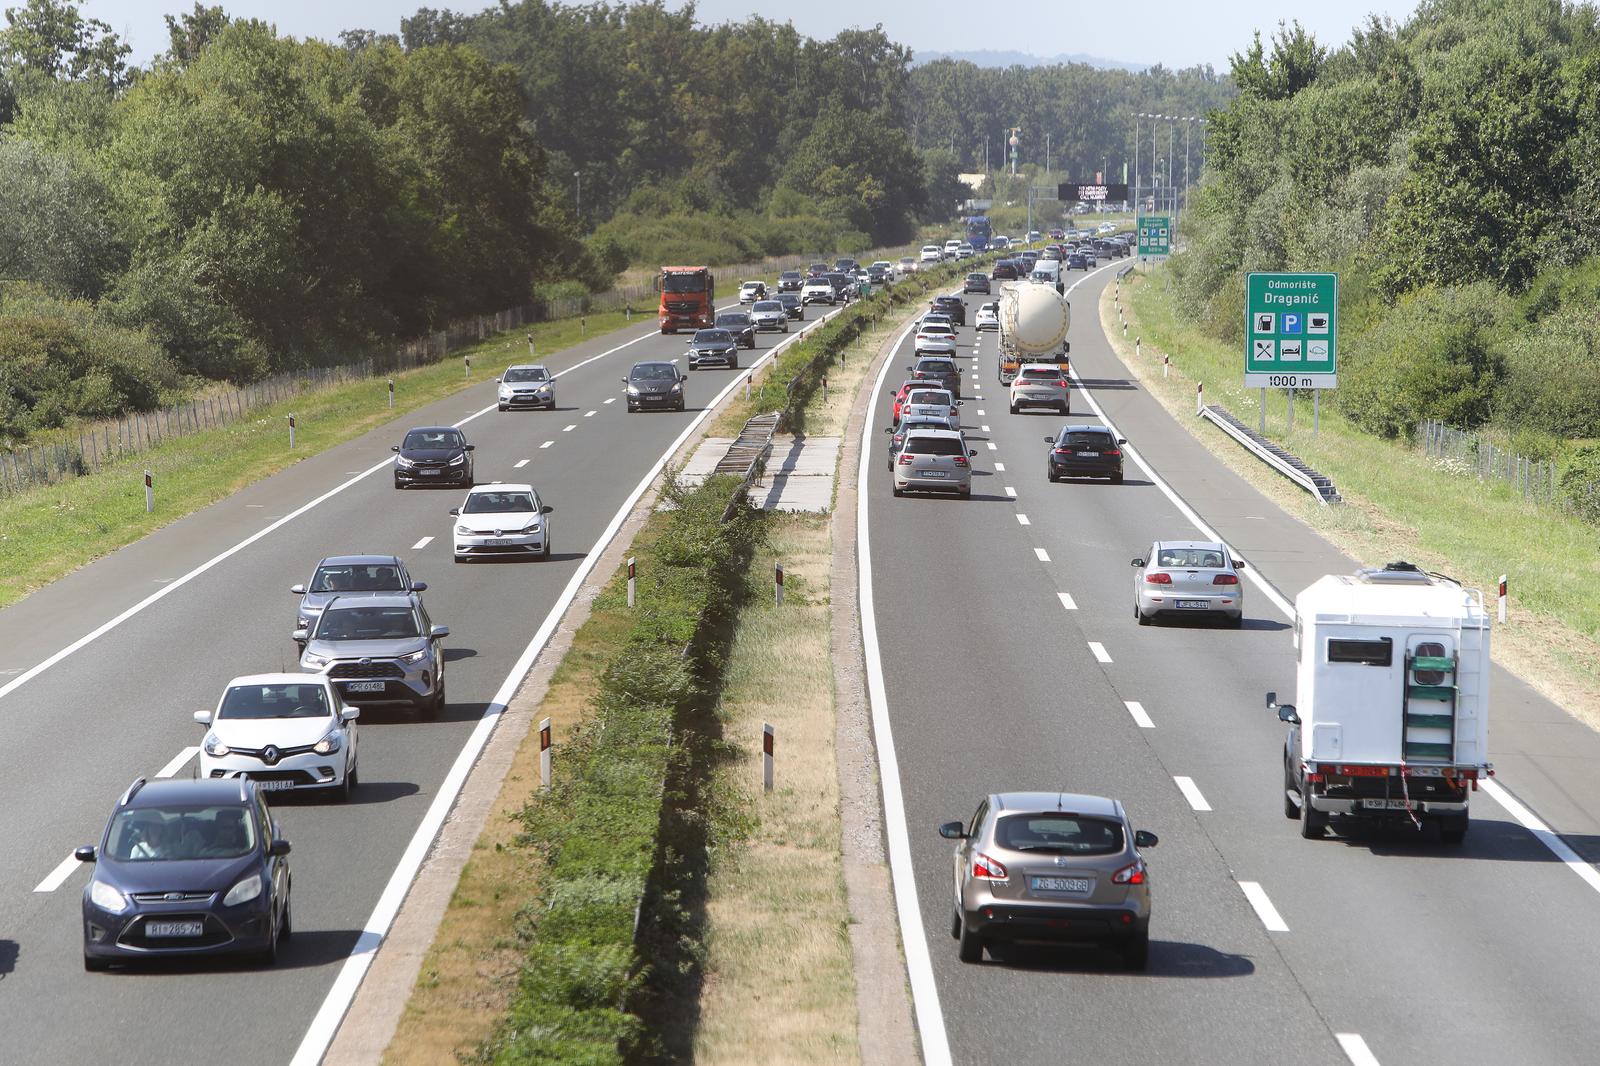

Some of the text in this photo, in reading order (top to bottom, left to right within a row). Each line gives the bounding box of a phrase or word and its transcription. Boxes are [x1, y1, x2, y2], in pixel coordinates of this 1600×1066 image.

[1268, 279, 1317, 289] Odmorište
[1264, 292, 1319, 307] Draganić
[1285, 315, 1298, 332] P
[1269, 376, 1313, 387] 1000 m
[1039, 879, 1049, 889] ZG
